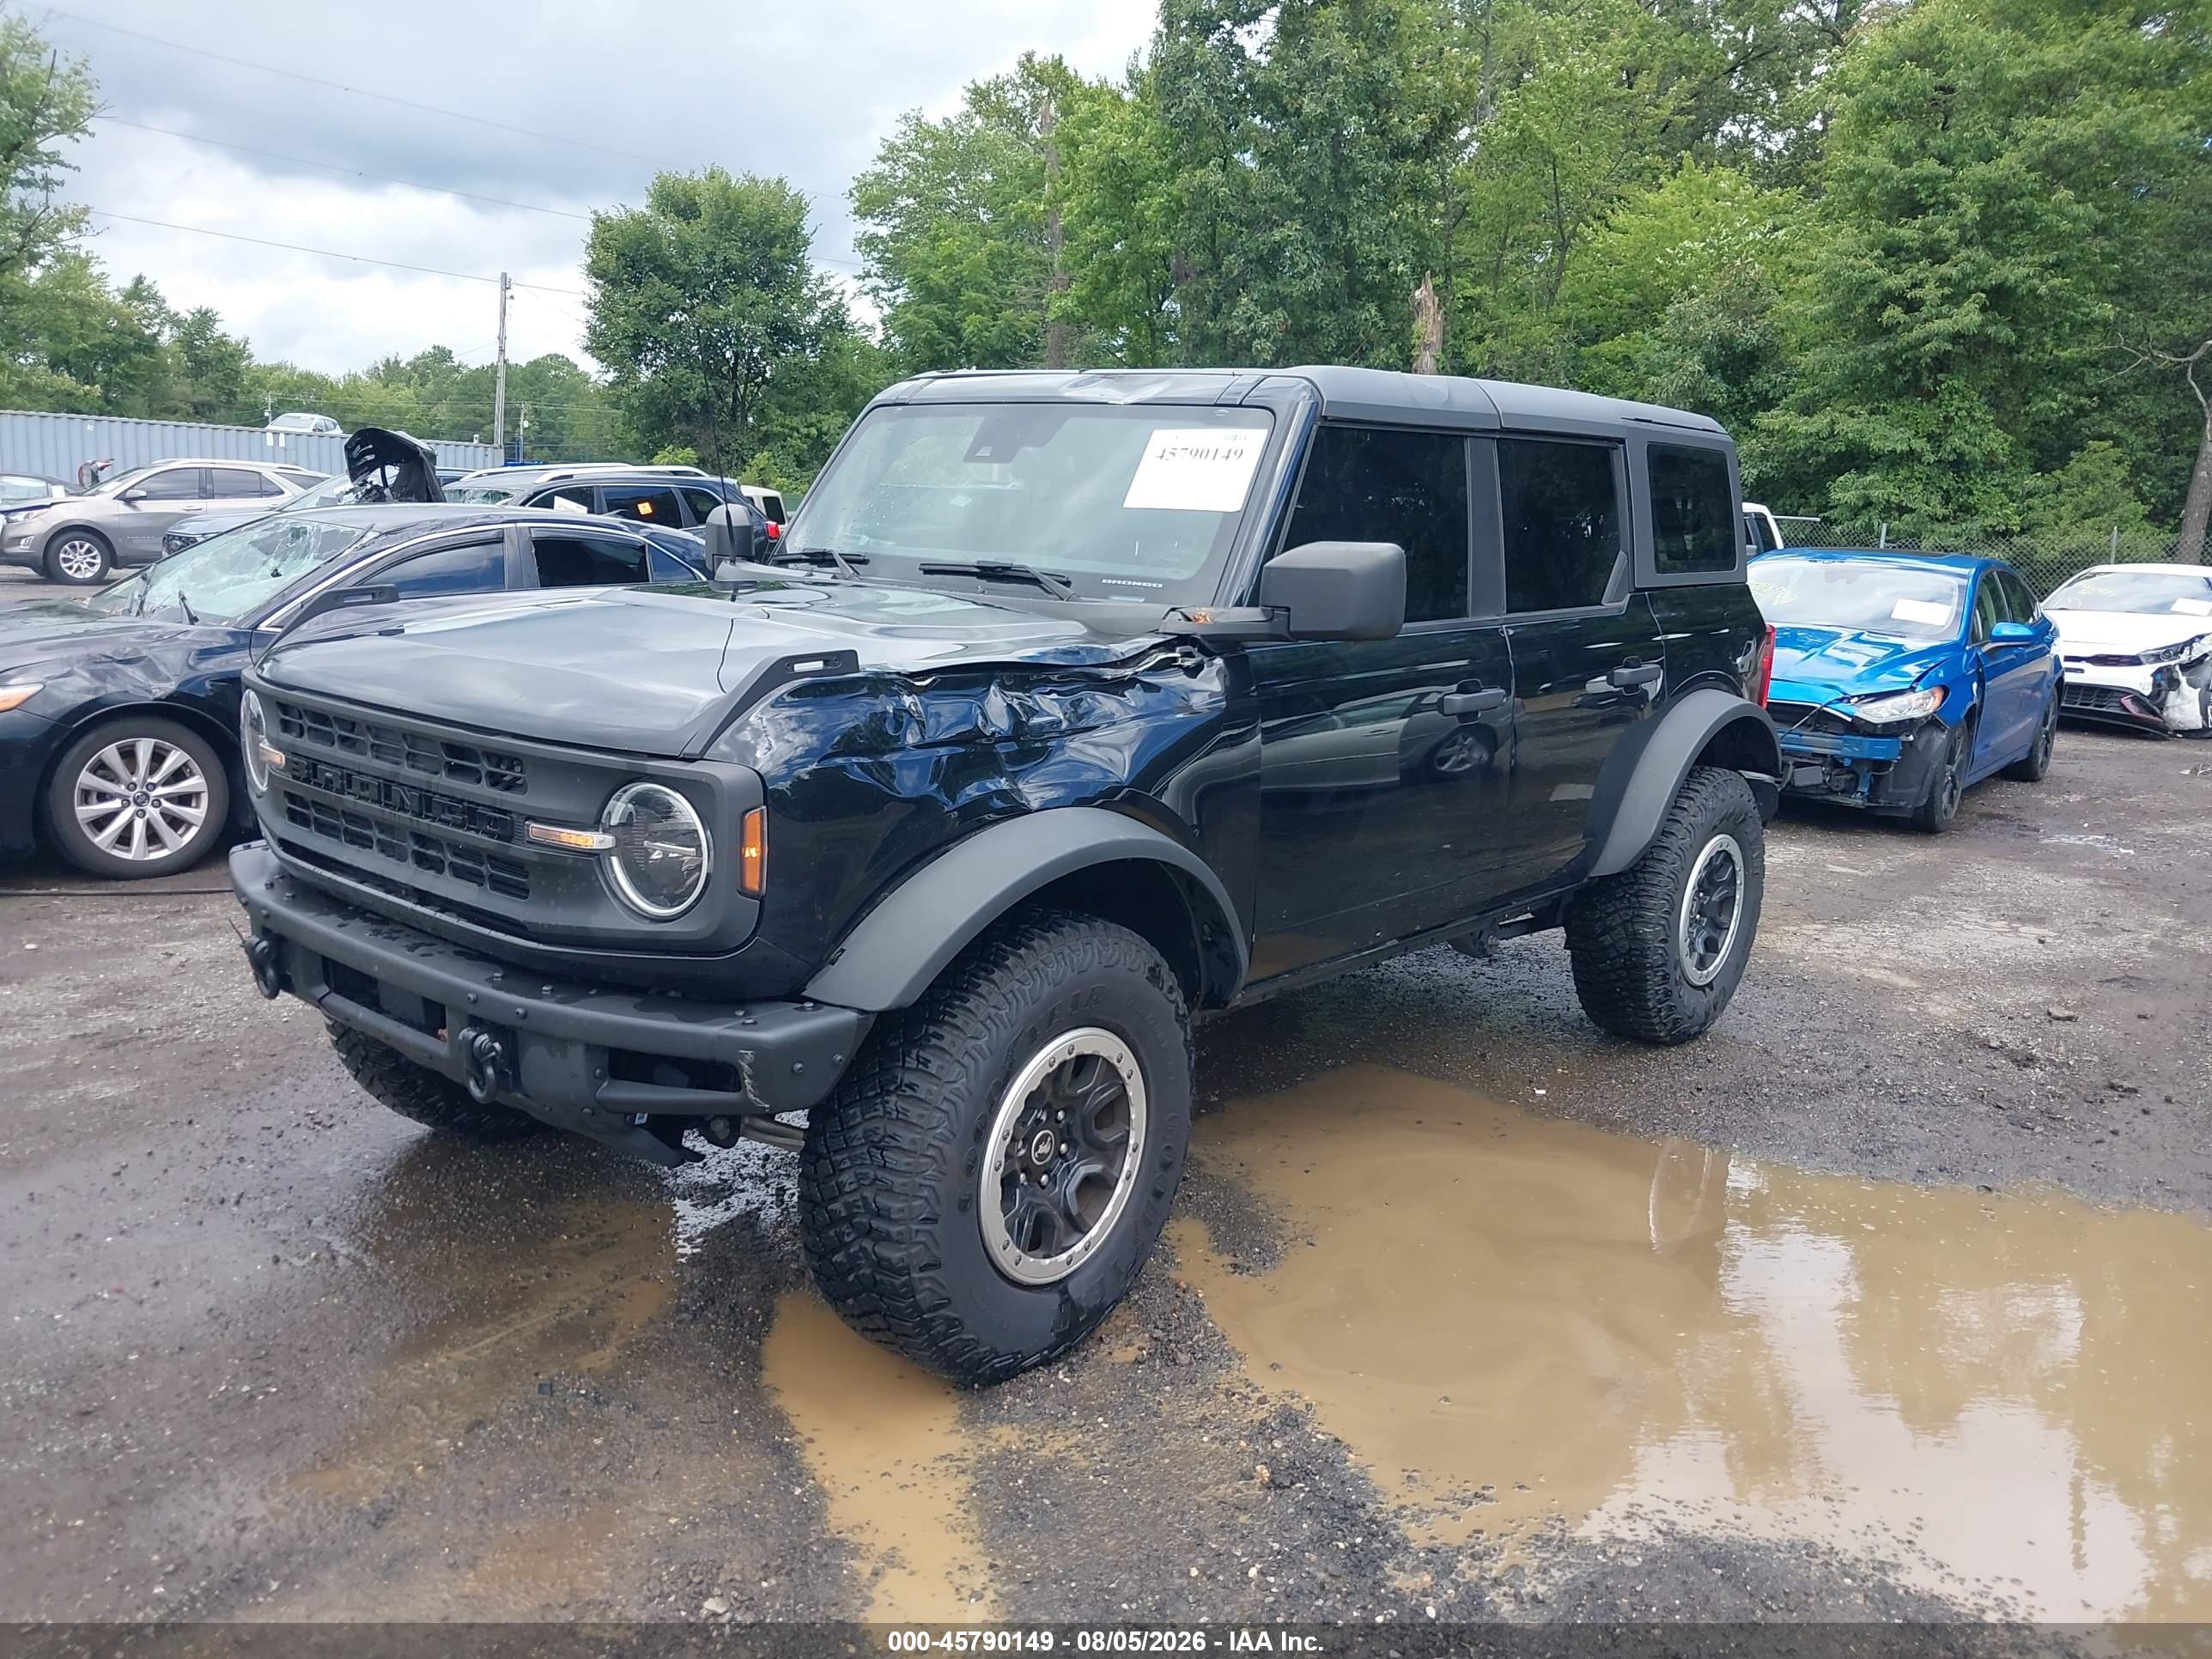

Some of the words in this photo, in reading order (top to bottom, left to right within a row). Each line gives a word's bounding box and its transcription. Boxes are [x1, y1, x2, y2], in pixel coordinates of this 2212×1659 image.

[1155, 447, 1244, 461] 45790149
[1101, 578, 1164, 588] BRONCO
[284, 751, 513, 843] BRONCO
